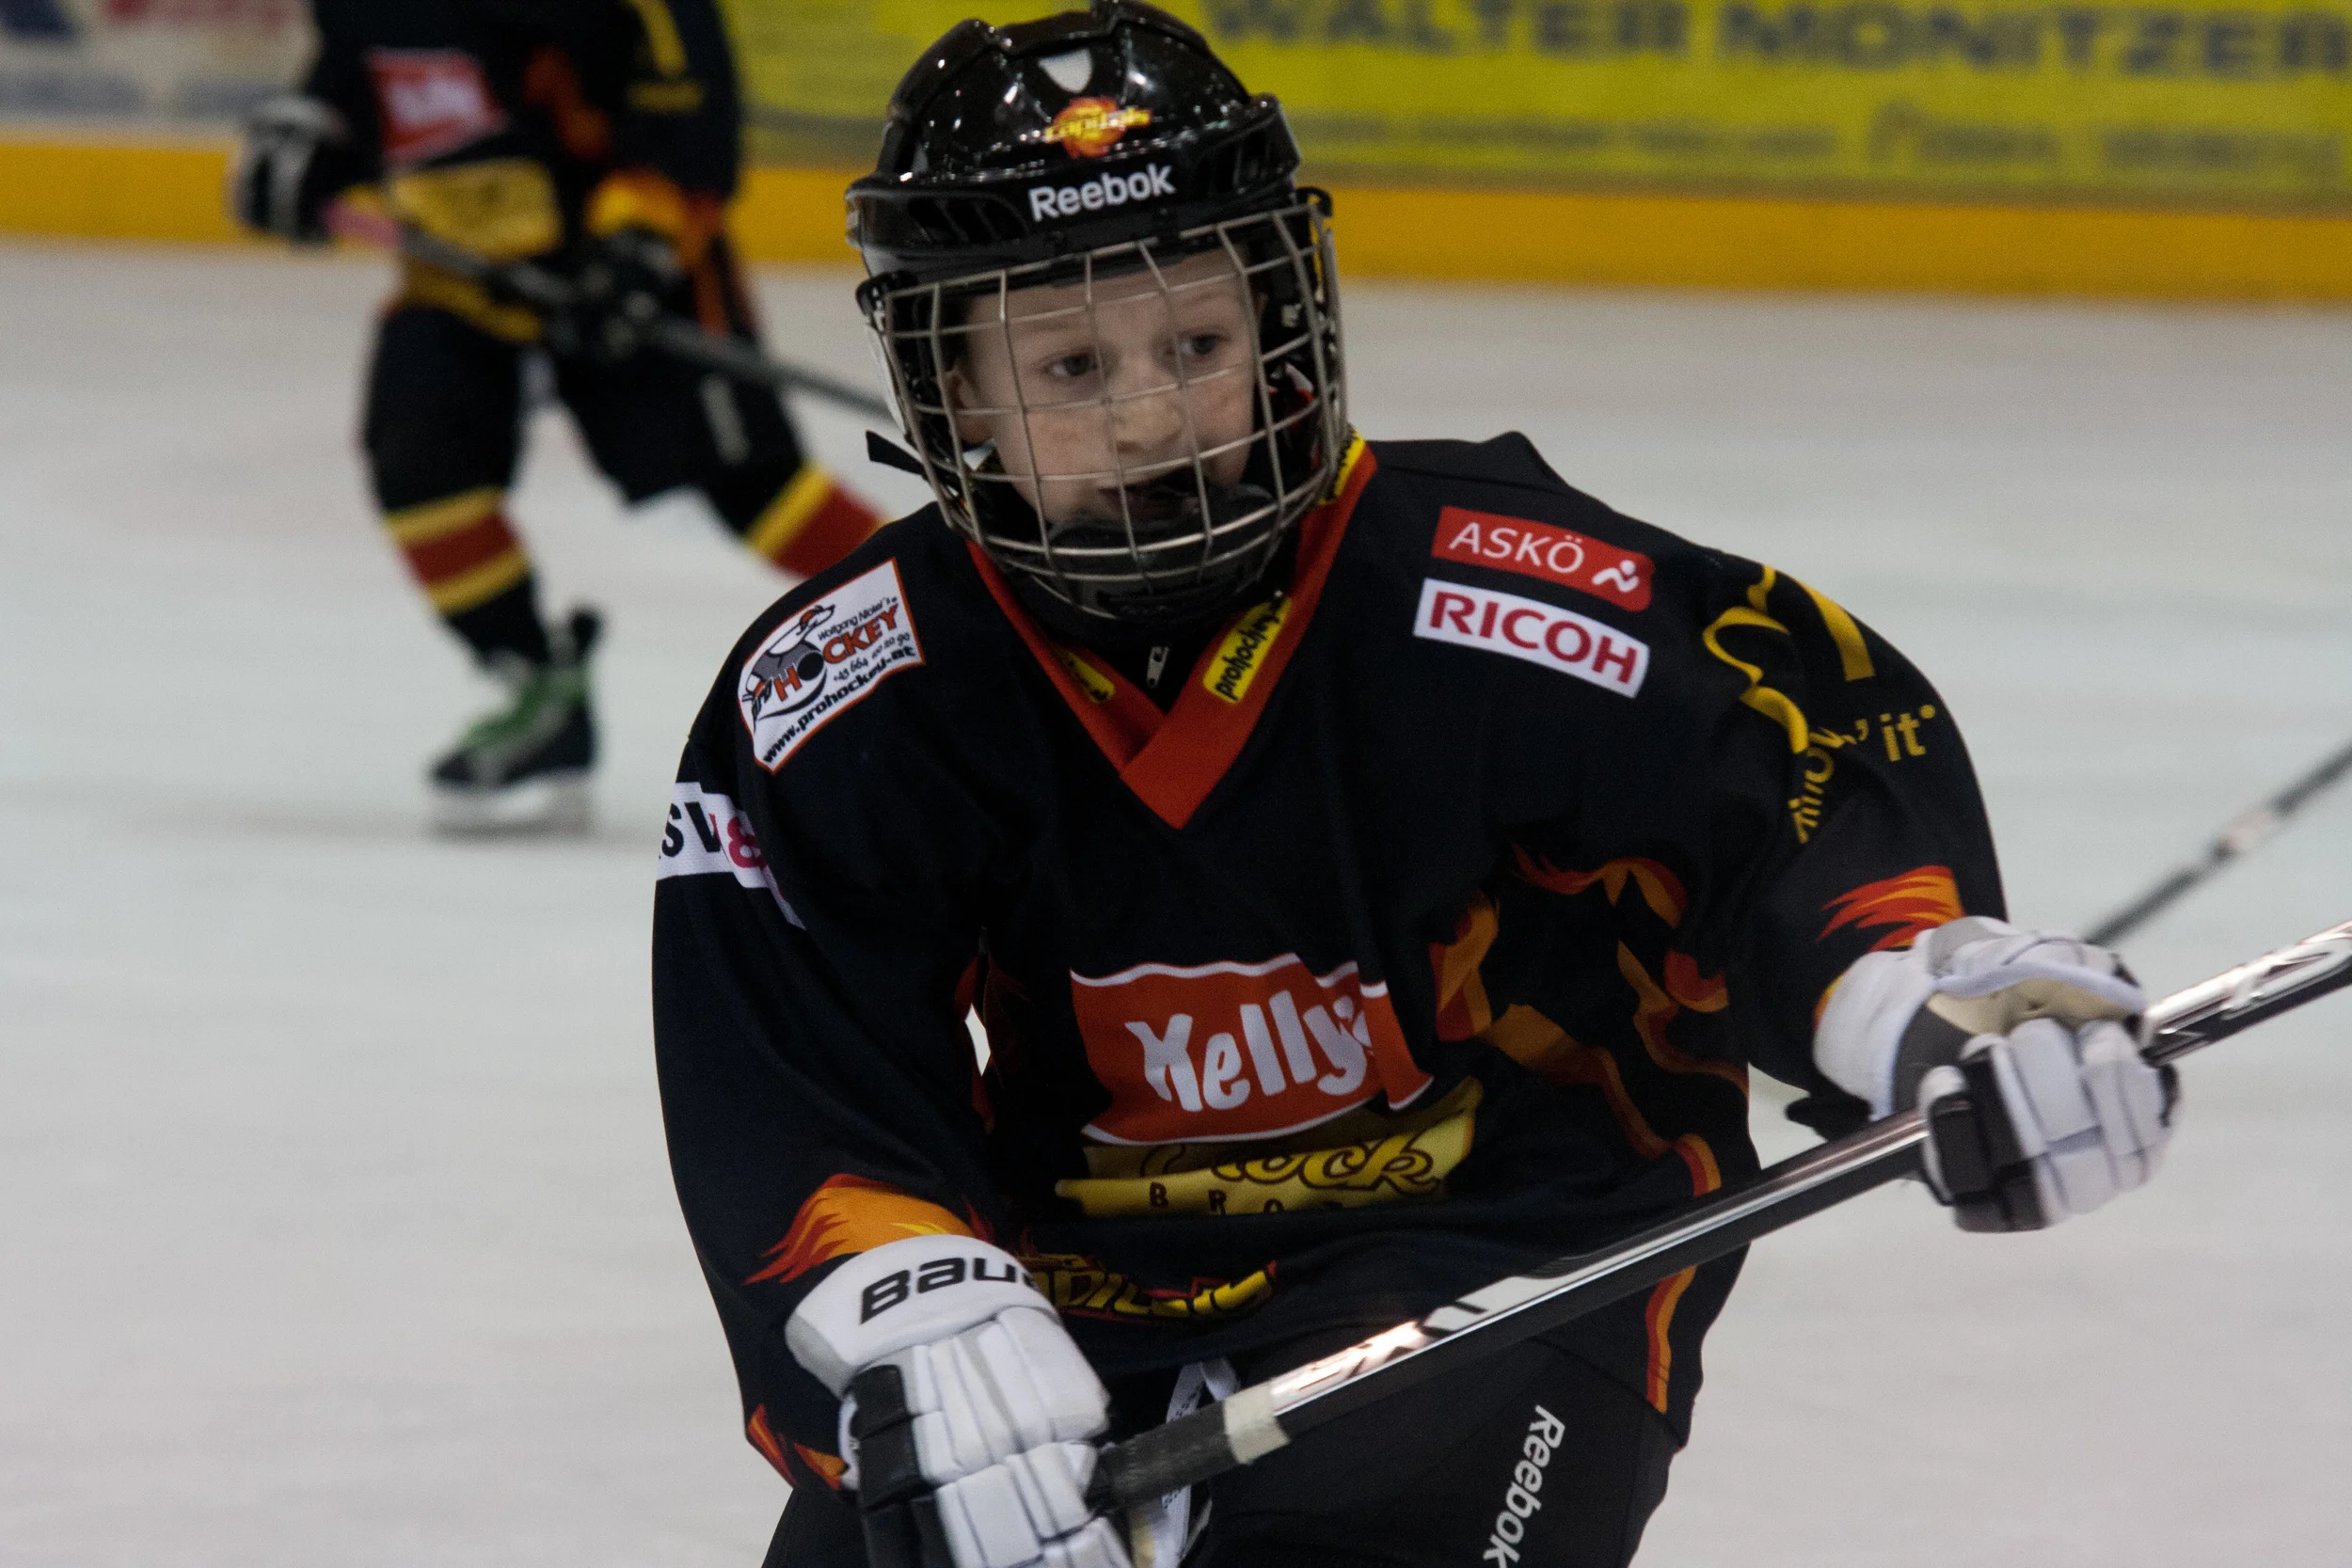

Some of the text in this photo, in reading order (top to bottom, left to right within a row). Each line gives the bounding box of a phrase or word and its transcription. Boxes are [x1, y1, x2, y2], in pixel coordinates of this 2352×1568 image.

[1027, 163, 1176, 222] Reebok
[1449, 522, 1584, 574] ASKÖ
[1429, 591, 1637, 685] RICOH
[1483, 1404, 1565, 1568] Reebok
